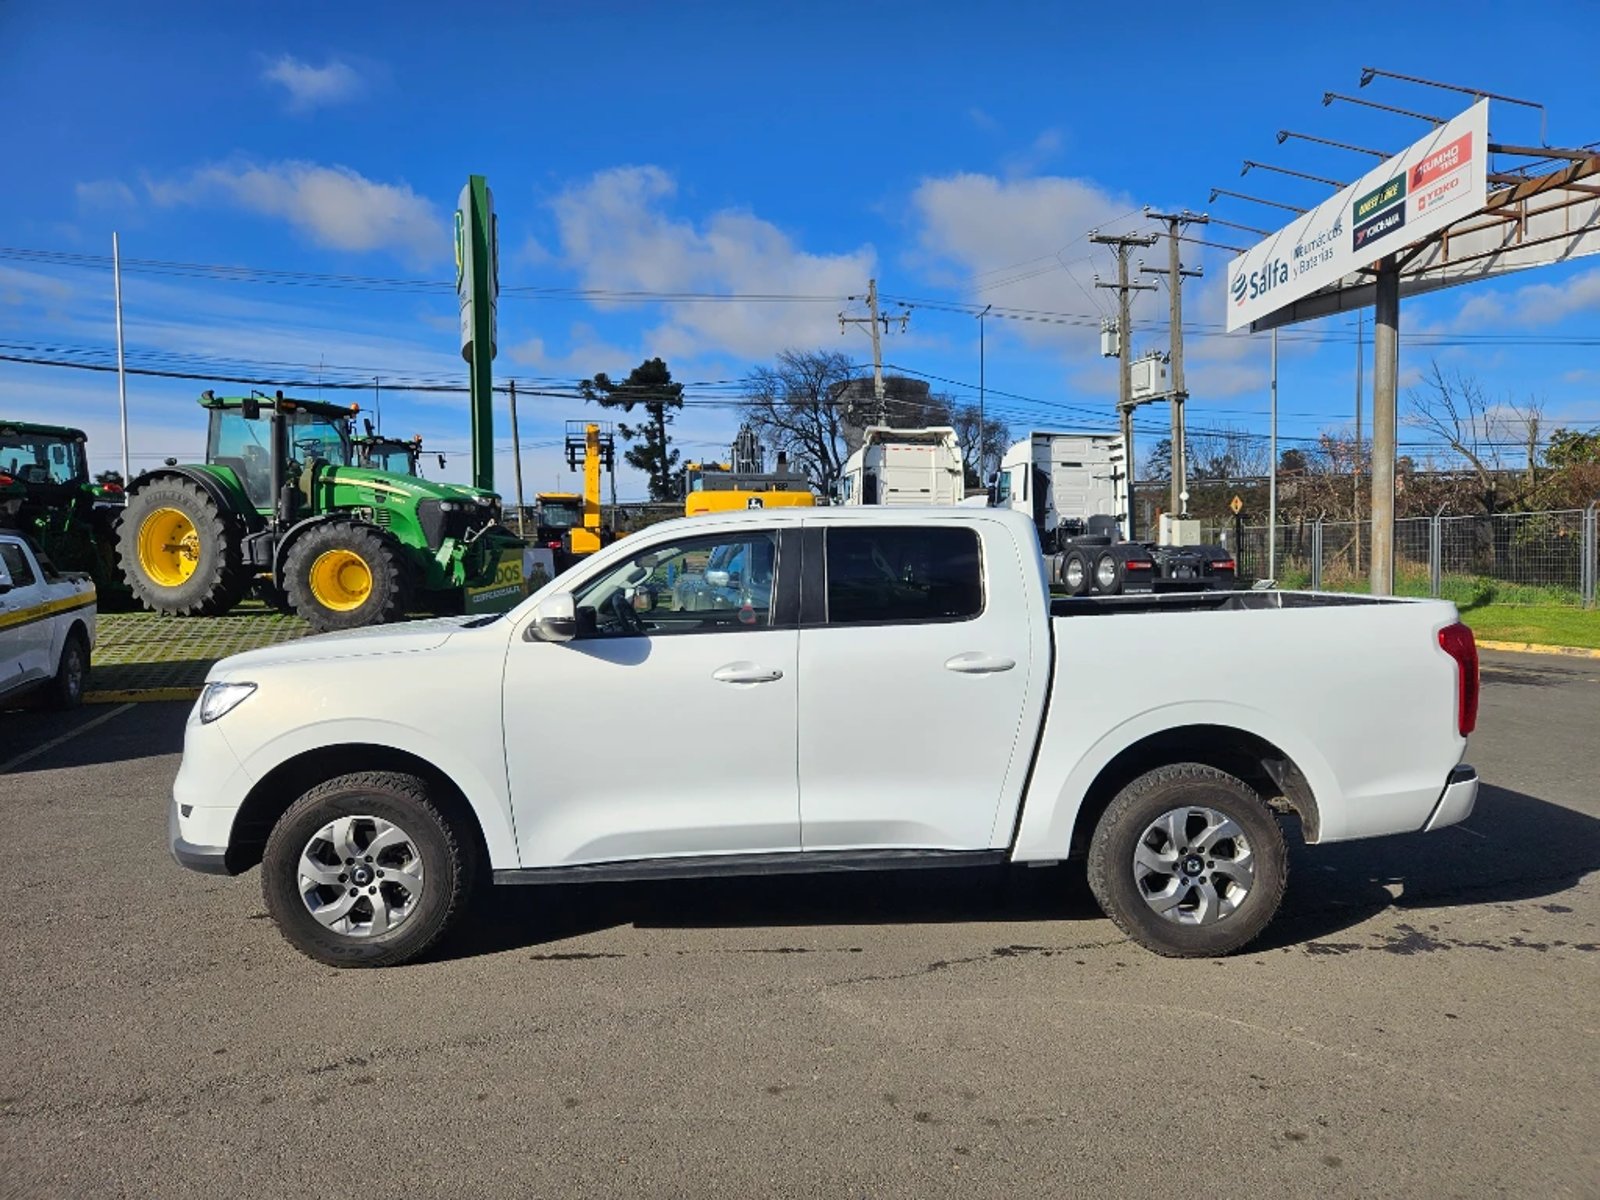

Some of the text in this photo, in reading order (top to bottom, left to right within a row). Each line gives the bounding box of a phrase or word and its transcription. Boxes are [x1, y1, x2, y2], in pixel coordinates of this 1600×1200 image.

[1425, 177, 1459, 201] YOKO
[1250, 258, 1289, 299] Salfa
[496, 564, 520, 584] DOS
